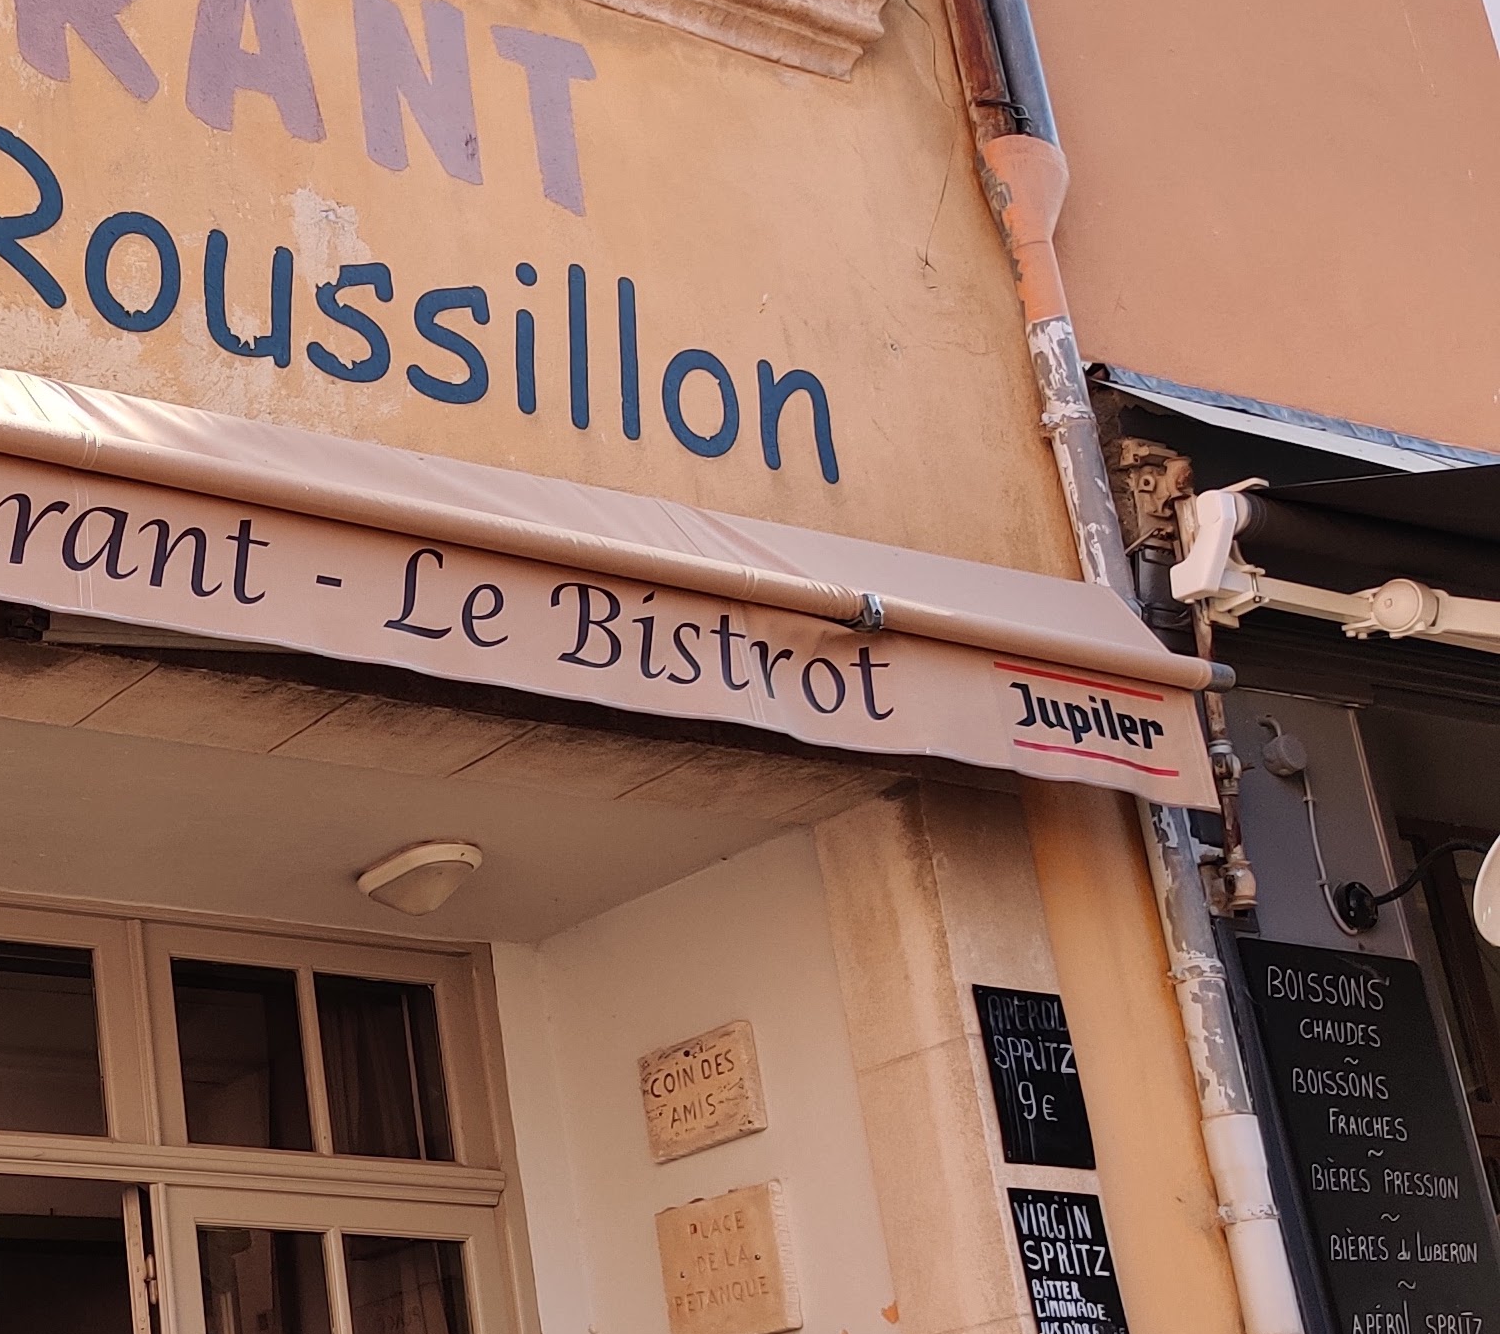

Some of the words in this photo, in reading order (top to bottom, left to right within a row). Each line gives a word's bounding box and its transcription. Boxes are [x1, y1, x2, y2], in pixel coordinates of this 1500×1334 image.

[384, 548, 512, 648] Le
[550, 581, 895, 722] Bistrot
[1009, 681, 1164, 749] Jupiler
[1267, 966, 1390, 1010] BOISSONS
[1299, 1018, 1381, 1047] CHAUDES
[650, 1062, 696, 1099] COIN
[701, 1049, 735, 1080] DES
[994, 1036, 1076, 1075] SPRITZ
[1292, 1068, 1389, 1099] BOISSONS
[670, 1092, 717, 1129] AMIS
[1311, 1157, 1371, 1193] BIÈRES
[1384, 1169, 1459, 1199] PRESSION
[688, 1210, 745, 1240] PLACE
[1013, 1195, 1092, 1240] VIRGIN
[696, 1252, 718, 1275] DE
[724, 1244, 750, 1267] LA
[1024, 1240, 1110, 1276] SPRITZ
[1330, 1228, 1389, 1261] BIÈRES
[1417, 1231, 1478, 1264] LUBERON
